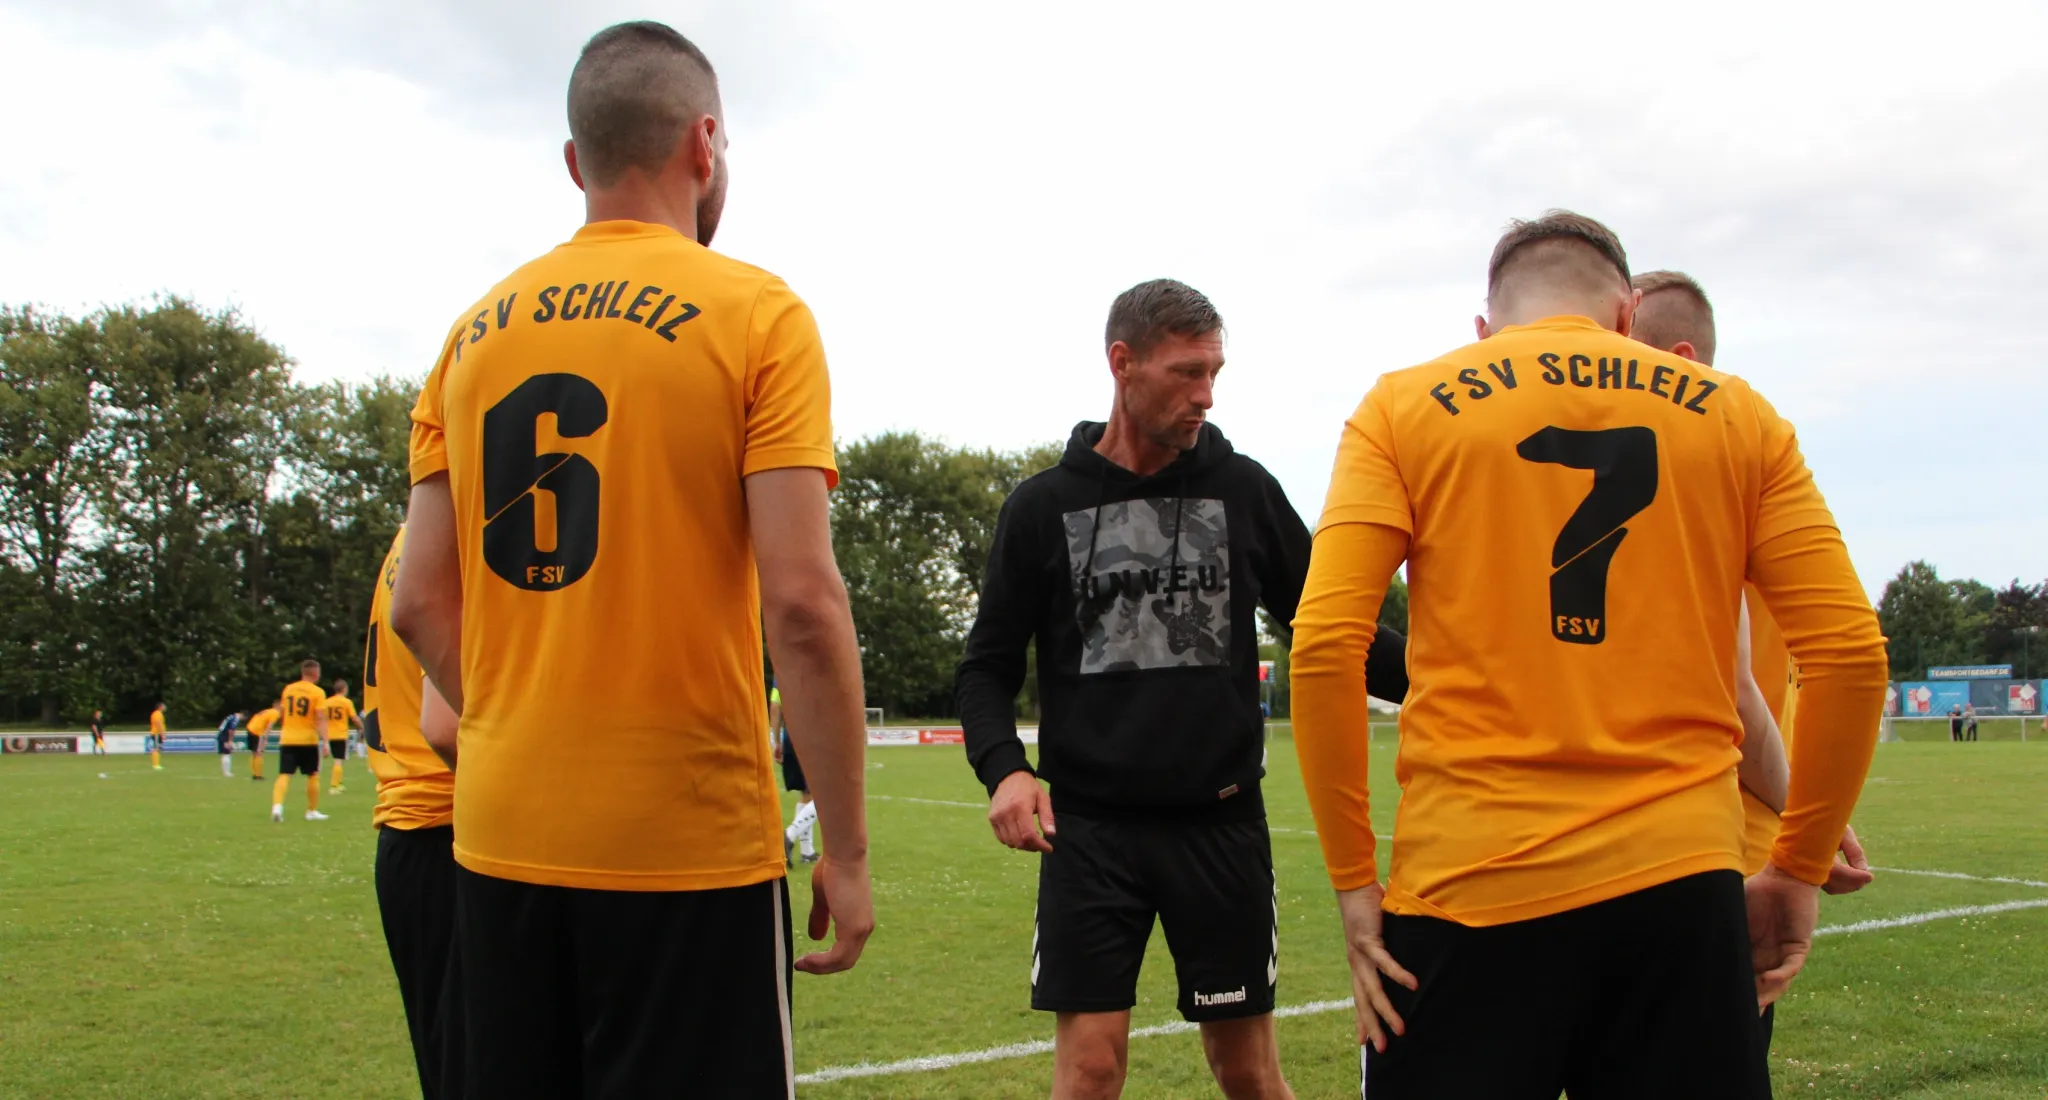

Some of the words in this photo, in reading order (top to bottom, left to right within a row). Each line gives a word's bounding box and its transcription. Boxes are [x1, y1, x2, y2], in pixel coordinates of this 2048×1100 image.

[455, 292, 518, 363] FSV
[533, 280, 702, 343] SCHLEIZ
[1430, 358, 1518, 416] FSV
[1537, 352, 1719, 415] SCHLEIZ
[483, 372, 608, 592] 6
[1516, 425, 1658, 645] 7
[526, 565, 566, 585] FSV
[1556, 615, 1600, 638] FSV
[287, 696, 310, 716] 19
[328, 707, 342, 720] 15
[1195, 986, 1246, 1006] hummel
